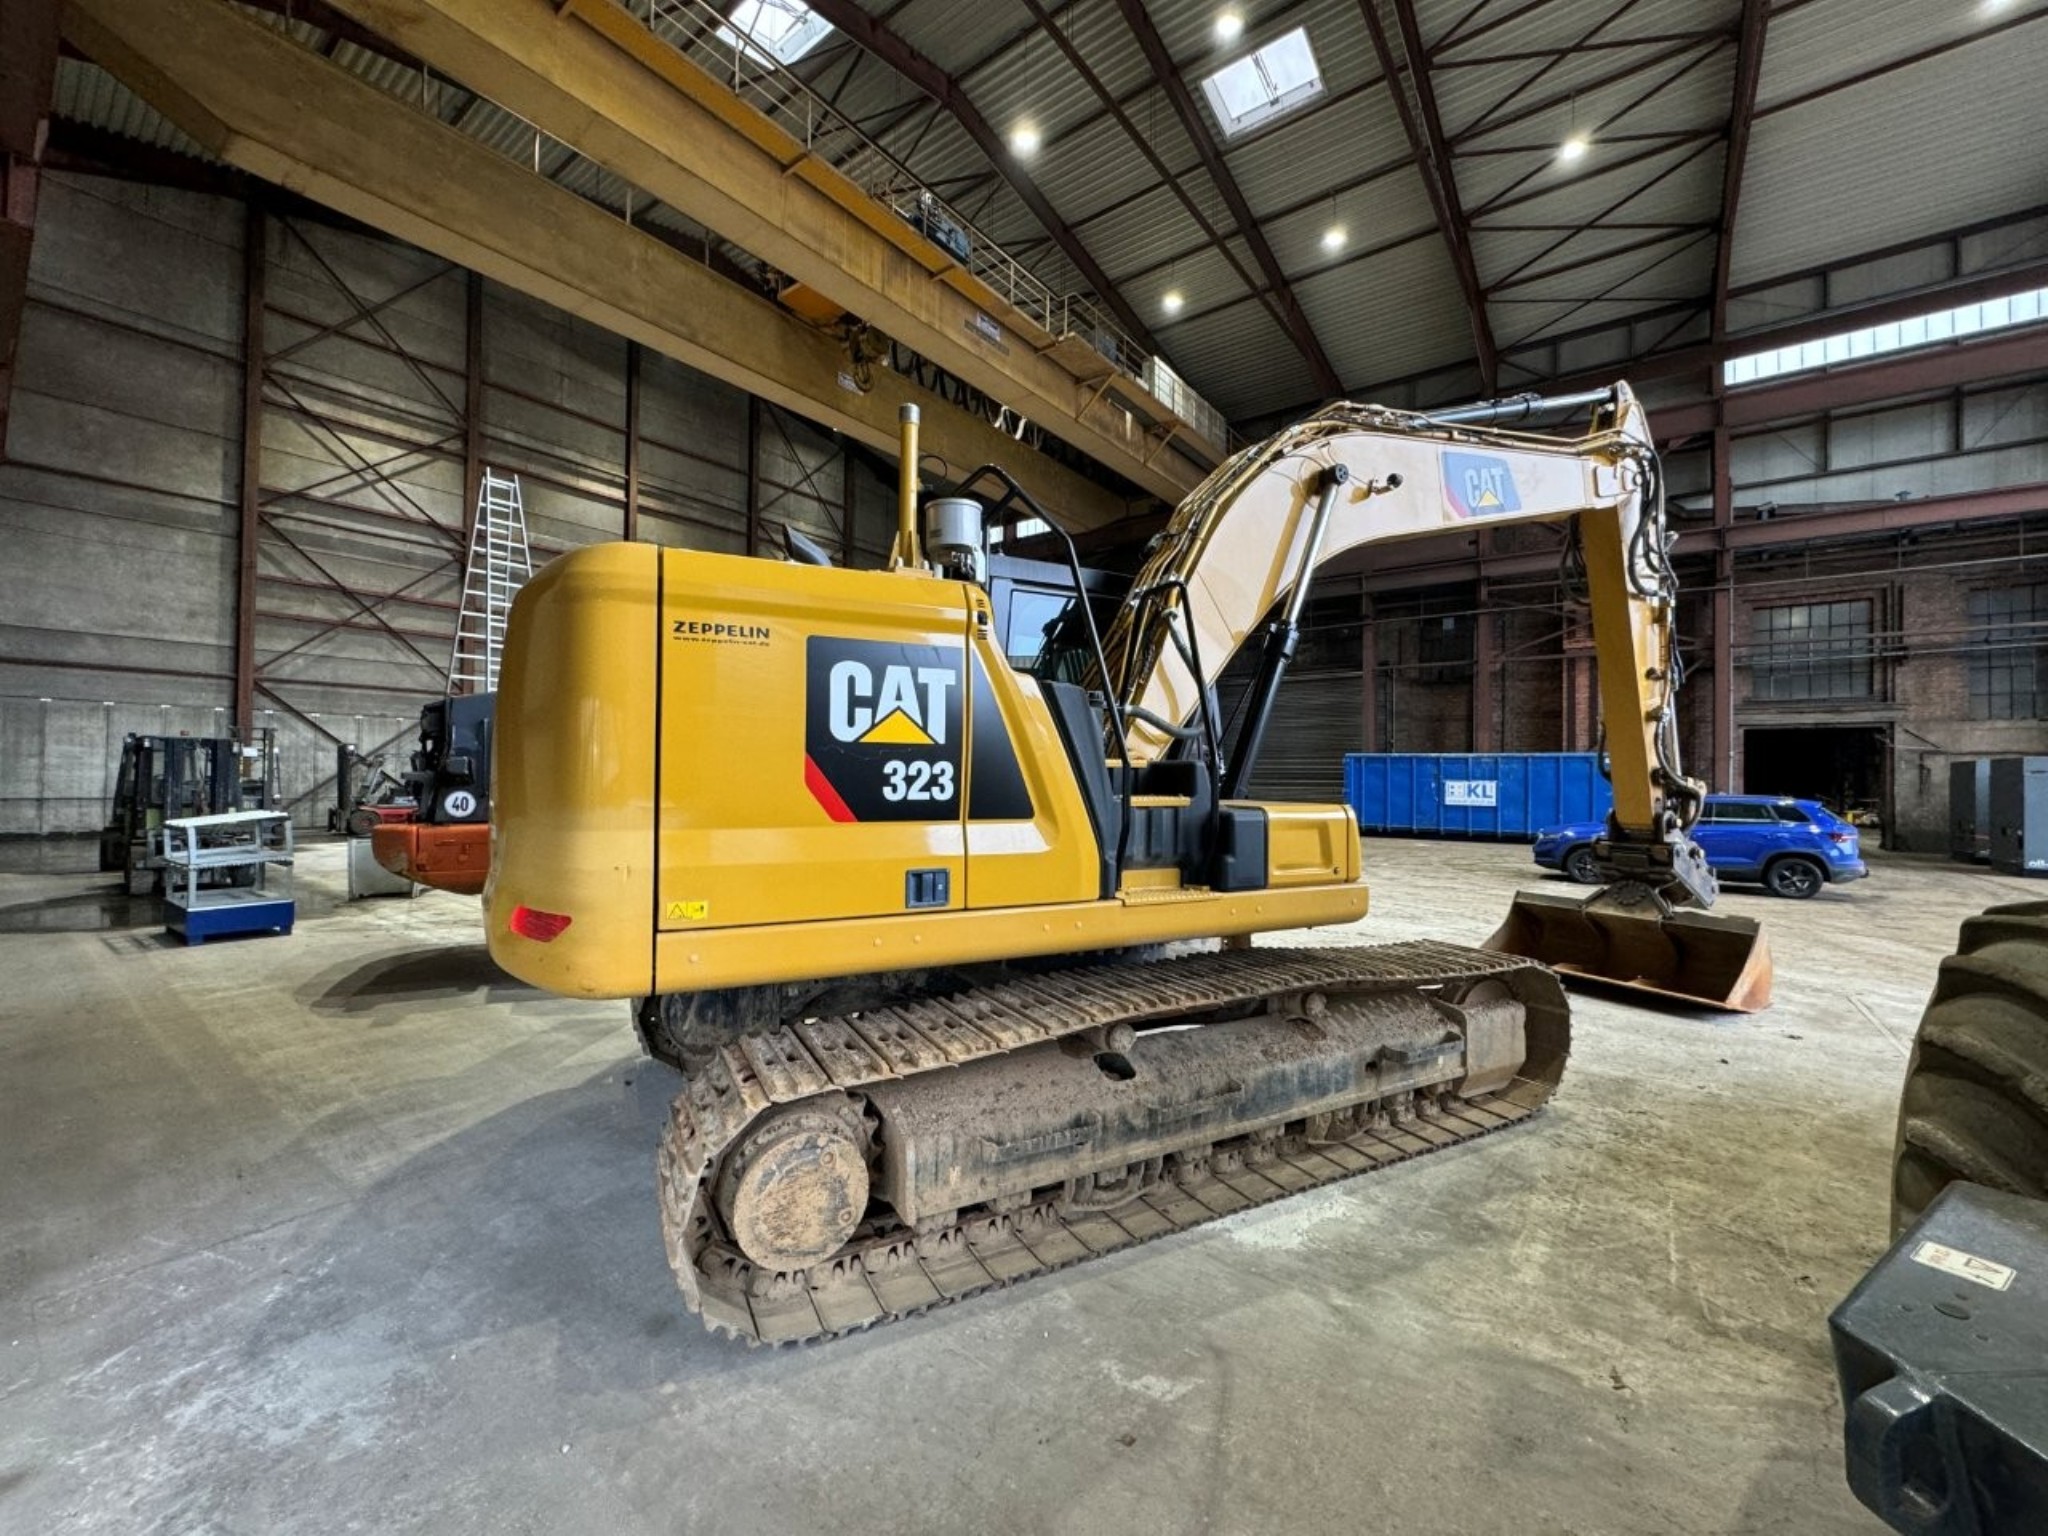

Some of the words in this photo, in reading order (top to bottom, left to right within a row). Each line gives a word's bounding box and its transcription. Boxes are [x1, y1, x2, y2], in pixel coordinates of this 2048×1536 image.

[1465, 468, 1505, 508] CAT
[673, 620, 769, 639] ZEPPELIN
[829, 660, 956, 744] CAT
[882, 760, 954, 802] 323
[452, 796, 469, 812] 40
